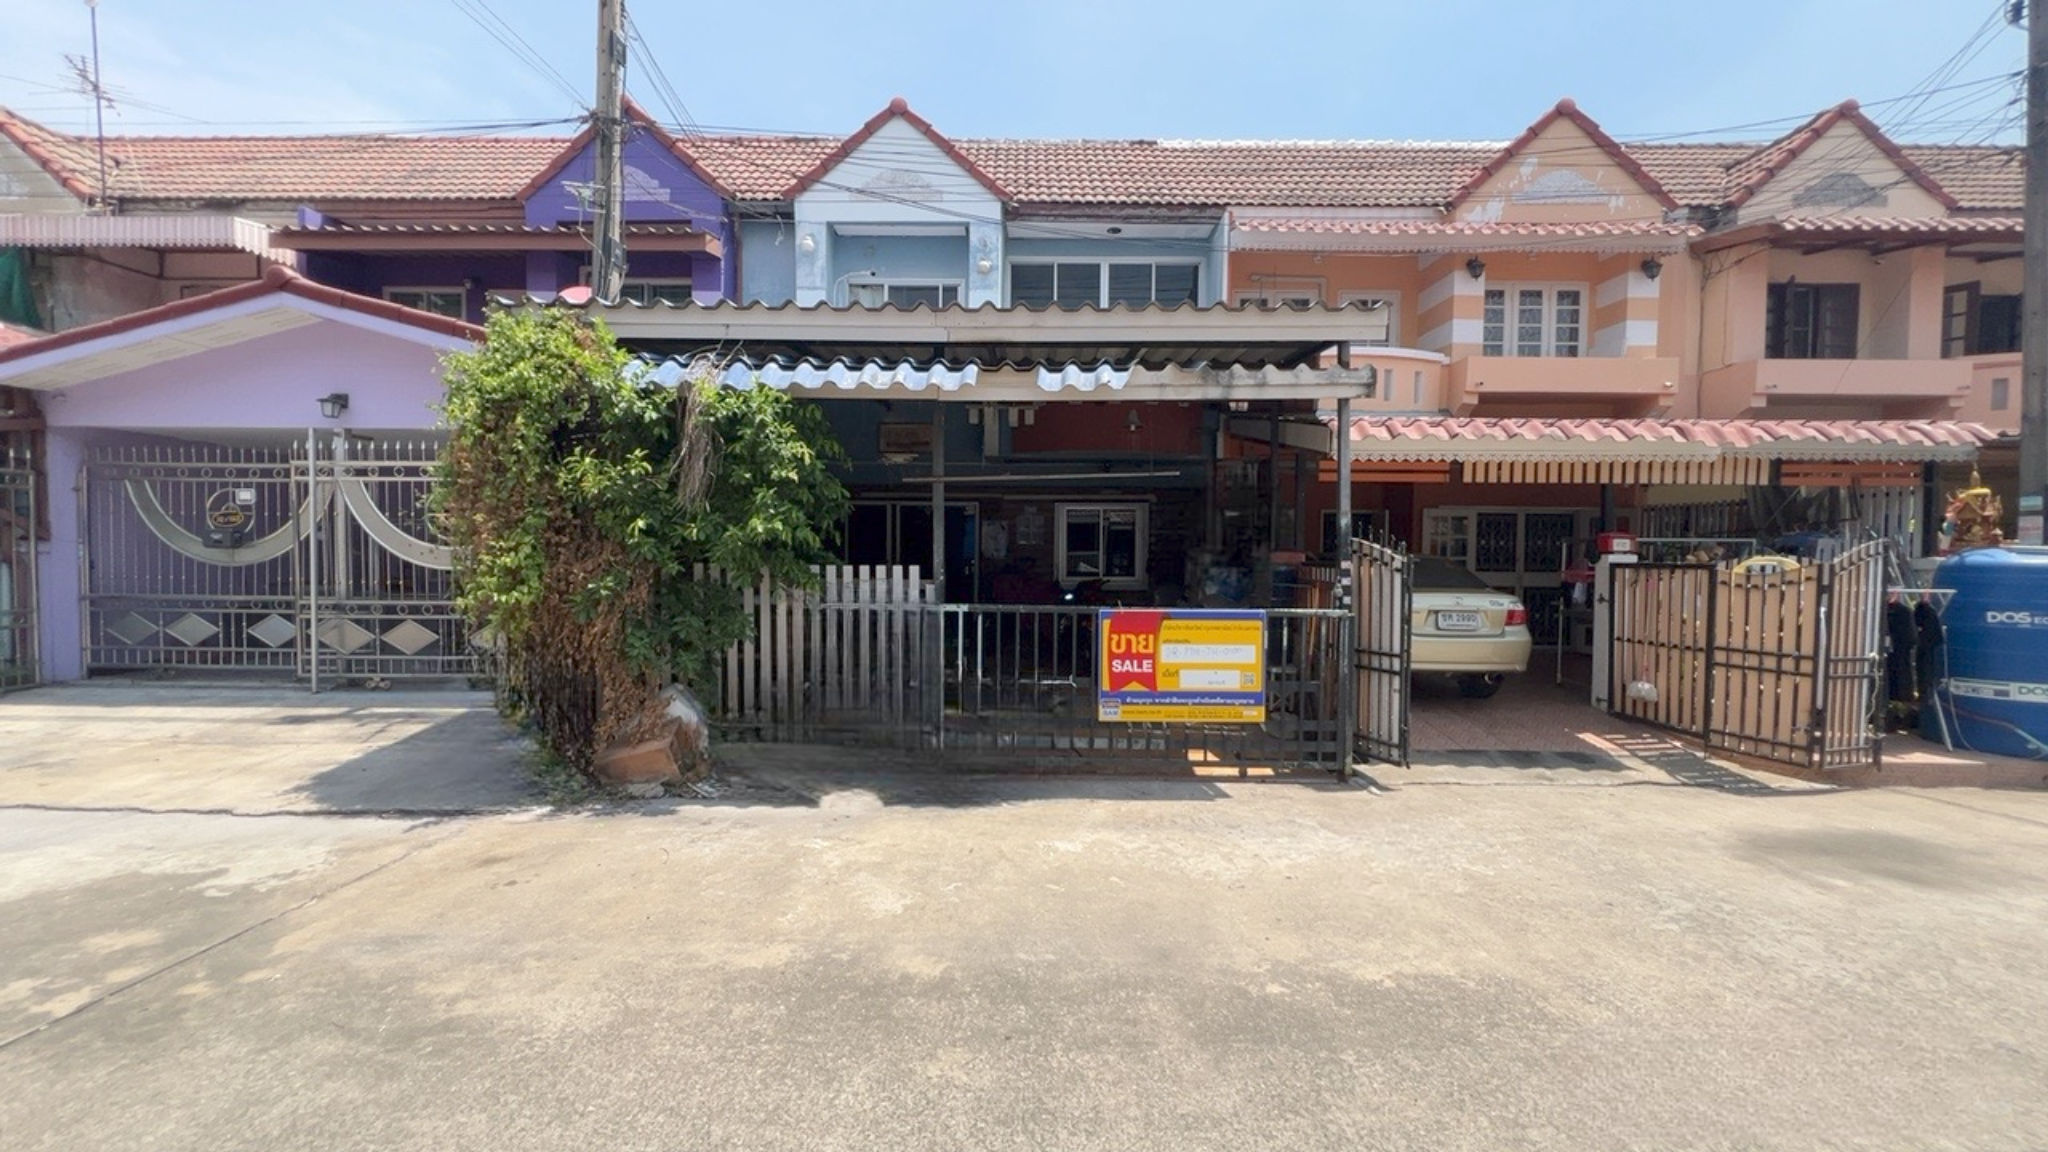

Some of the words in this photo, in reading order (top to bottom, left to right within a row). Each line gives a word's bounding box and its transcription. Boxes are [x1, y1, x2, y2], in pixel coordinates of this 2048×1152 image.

[1985, 611, 2032, 624] DOS
[1110, 633, 1155, 654] ขาย
[1111, 658, 1154, 673] SALE
